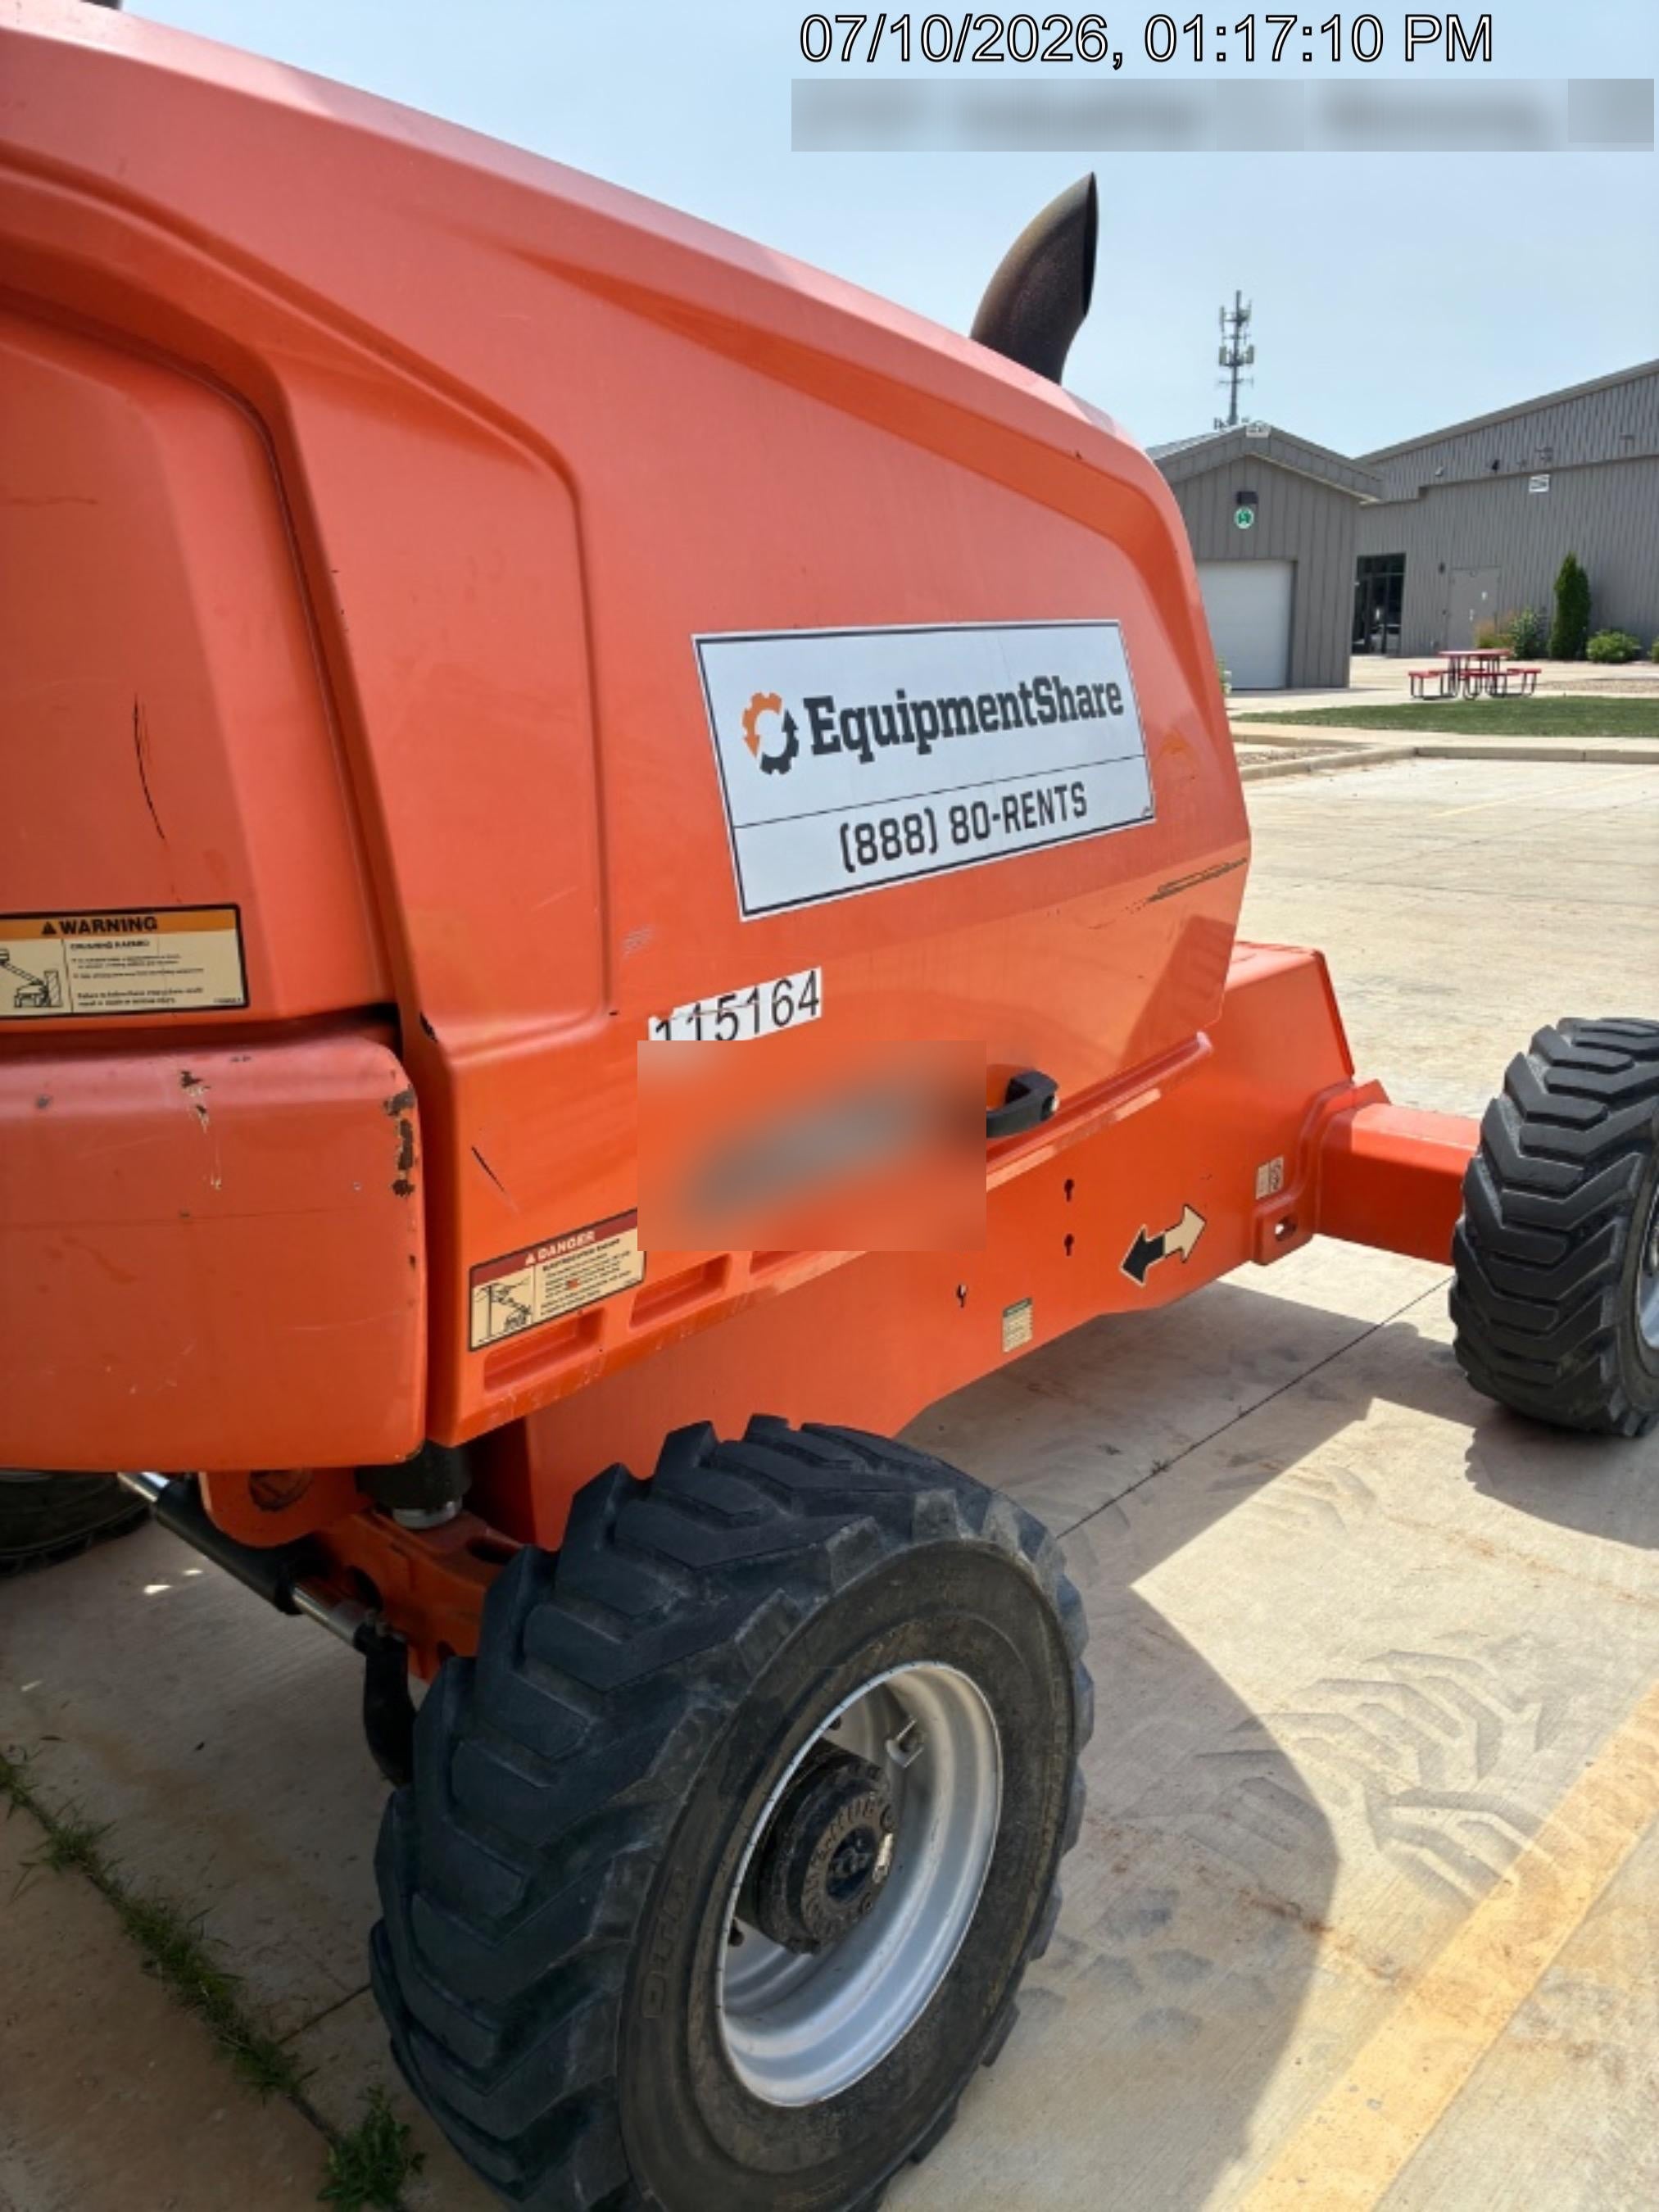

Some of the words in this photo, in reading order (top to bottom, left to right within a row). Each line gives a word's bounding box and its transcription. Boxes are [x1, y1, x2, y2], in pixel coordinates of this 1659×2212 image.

[803, 675, 1125, 764] EquipmentShare
[839, 808, 938, 873] (888)
[950, 781, 1088, 844] 80-RENTS
[59, 917, 158, 935] WARNING
[537, 1231, 596, 1261] DANGER
